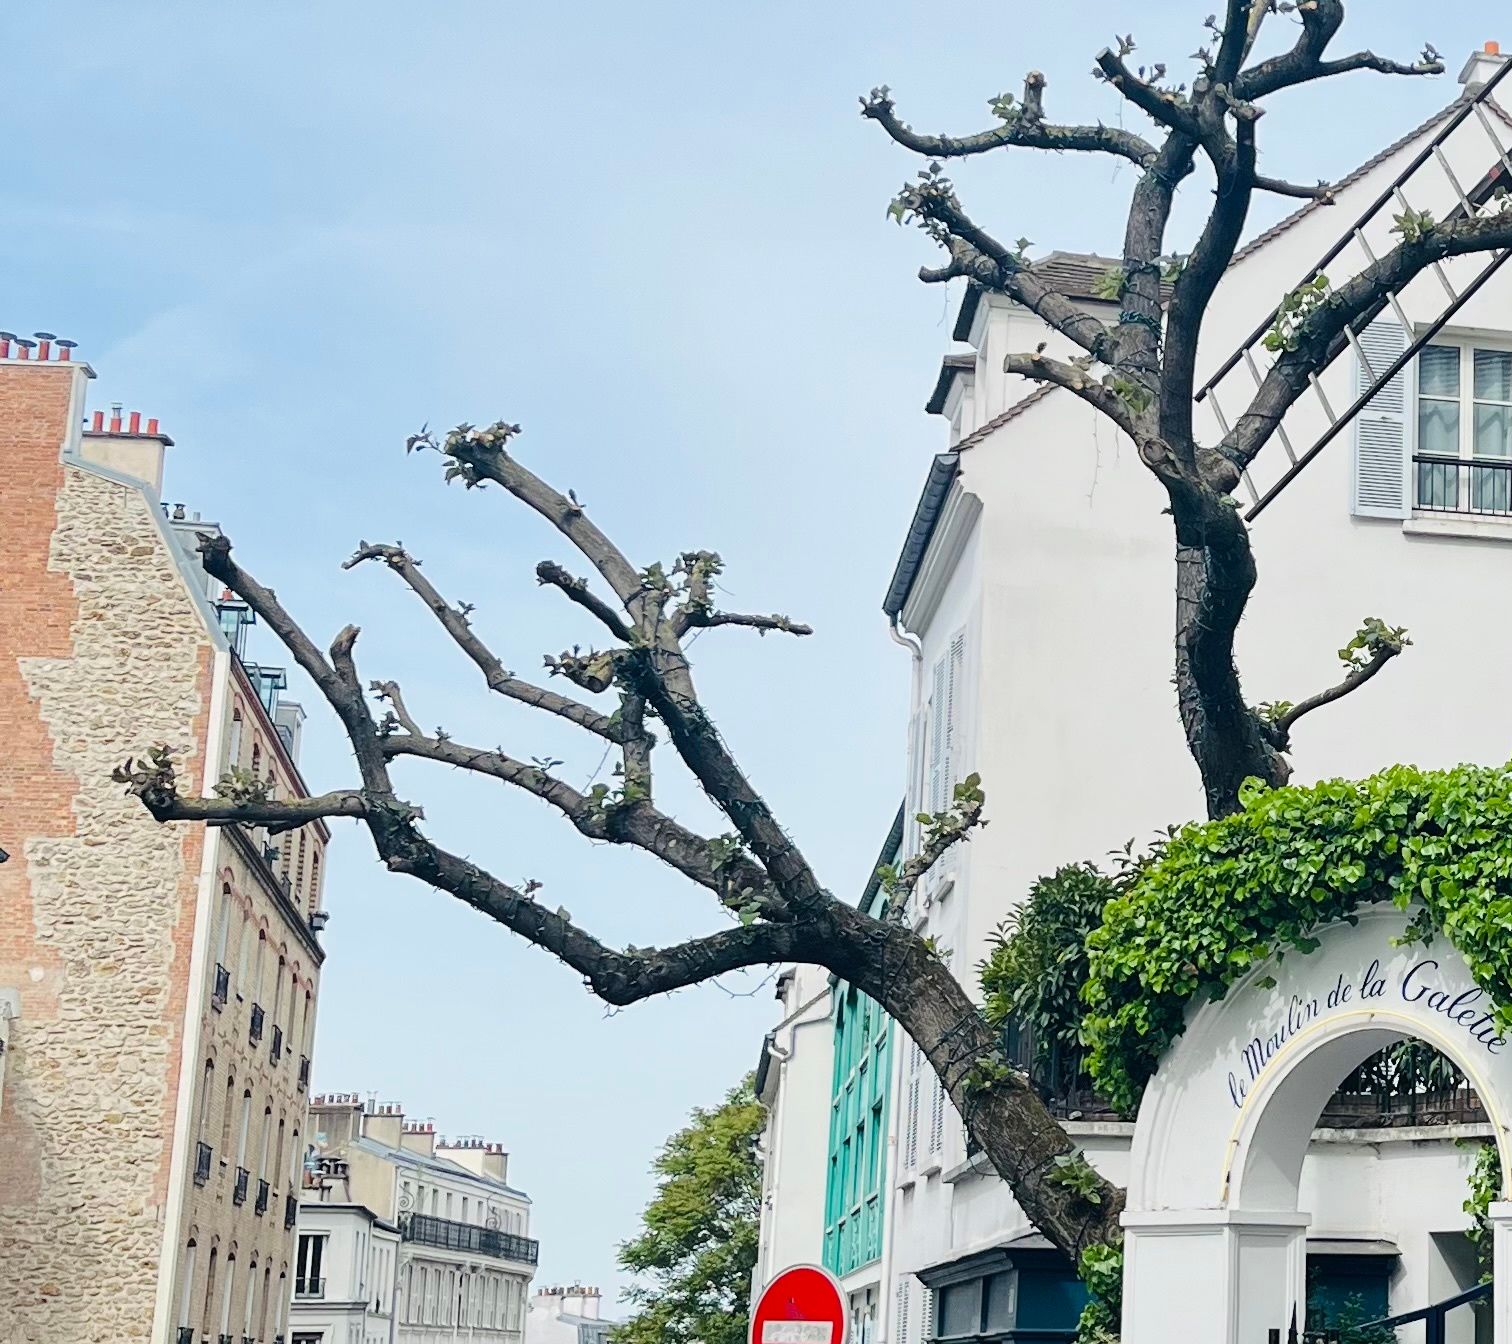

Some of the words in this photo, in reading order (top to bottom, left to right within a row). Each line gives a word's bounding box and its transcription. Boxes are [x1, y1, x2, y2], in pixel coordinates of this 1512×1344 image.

[1228, 1072, 1248, 1110] le
[1241, 994, 1321, 1083] Moulin
[1327, 973, 1352, 1009] de
[1359, 959, 1387, 1000] la
